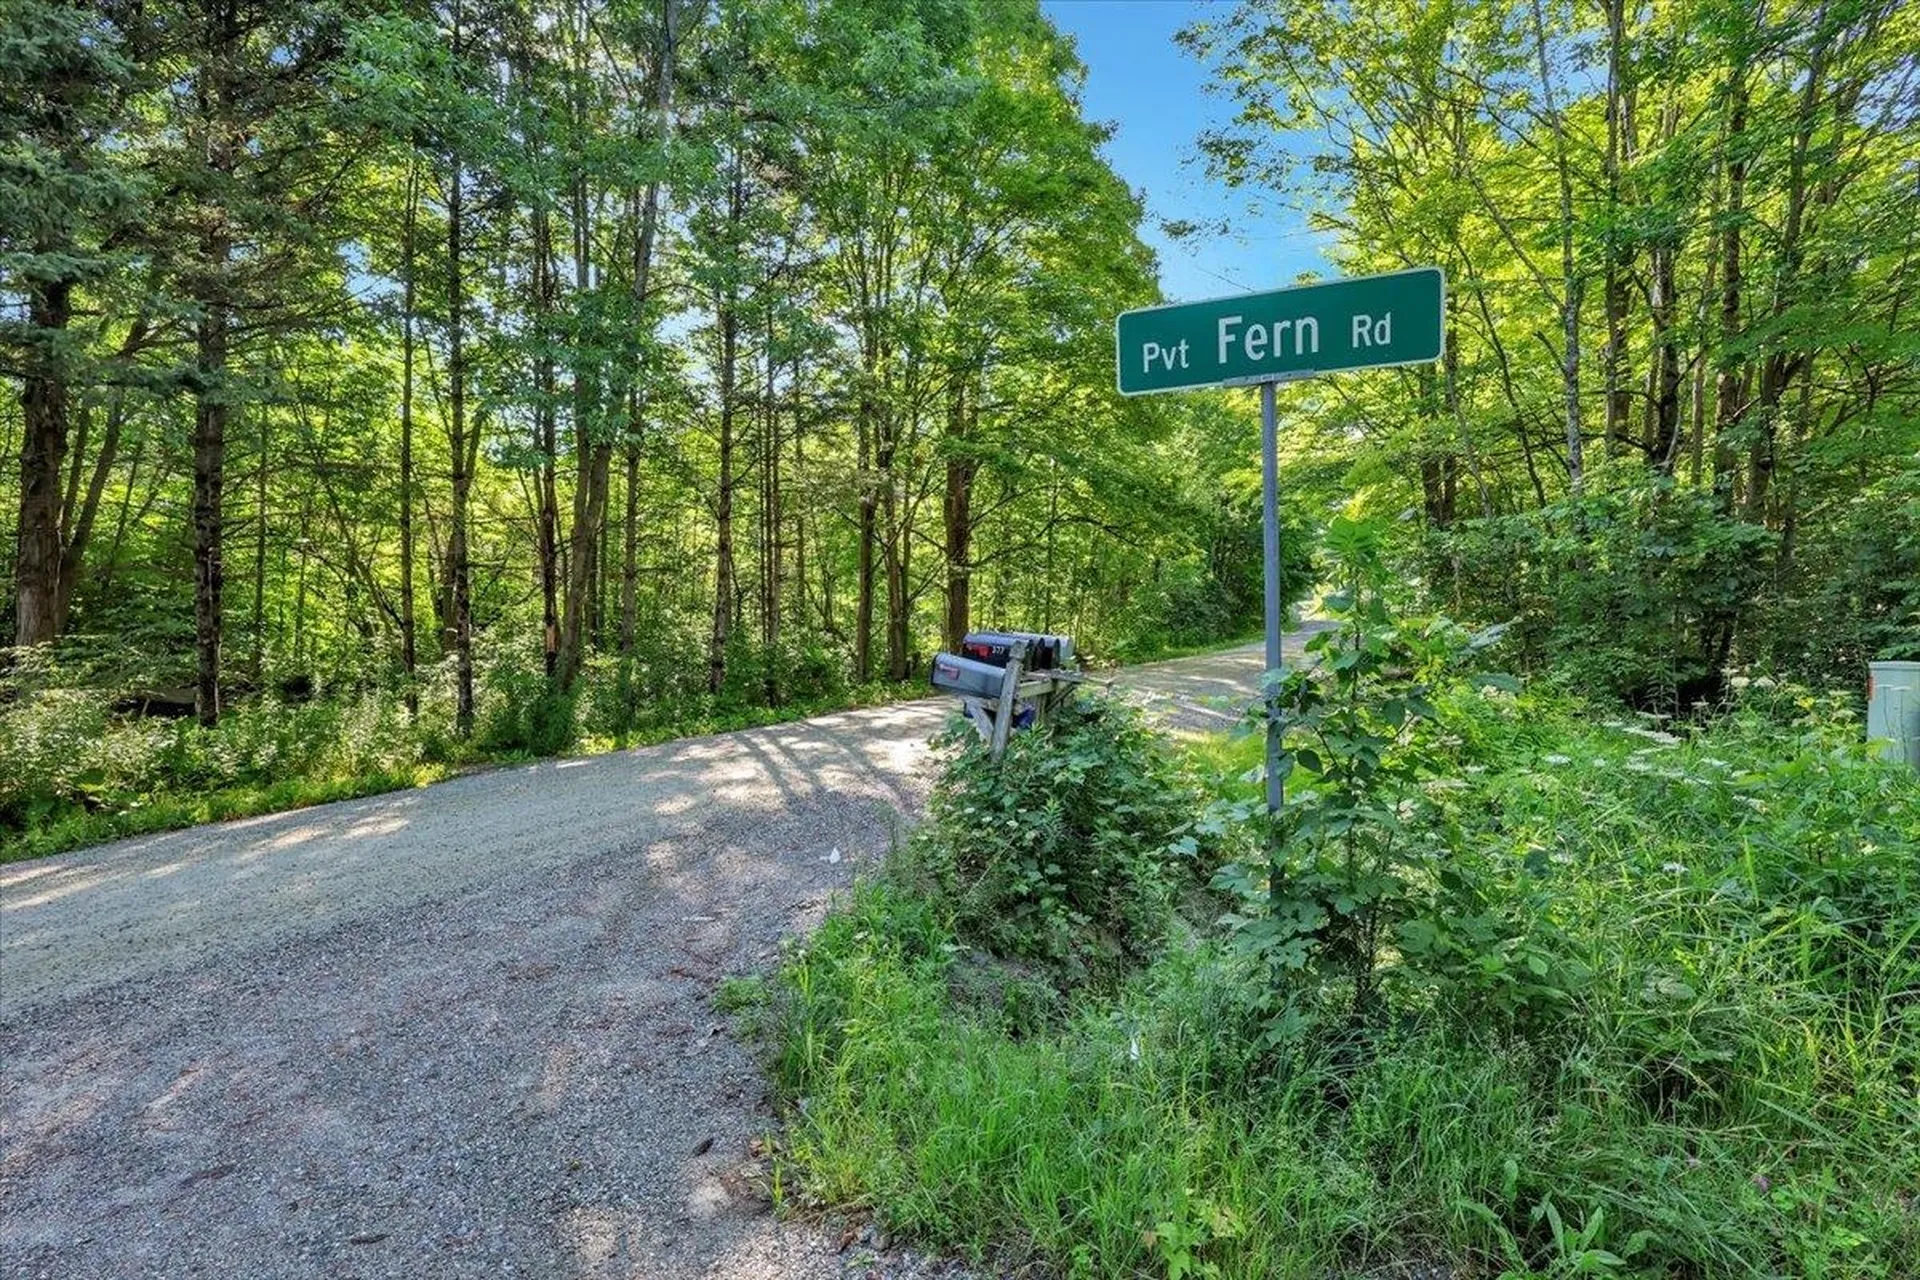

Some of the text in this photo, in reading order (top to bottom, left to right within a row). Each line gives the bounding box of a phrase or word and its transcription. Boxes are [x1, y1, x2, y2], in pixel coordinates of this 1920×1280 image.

[1143, 312, 1391, 373] Pvt Fern Rd
